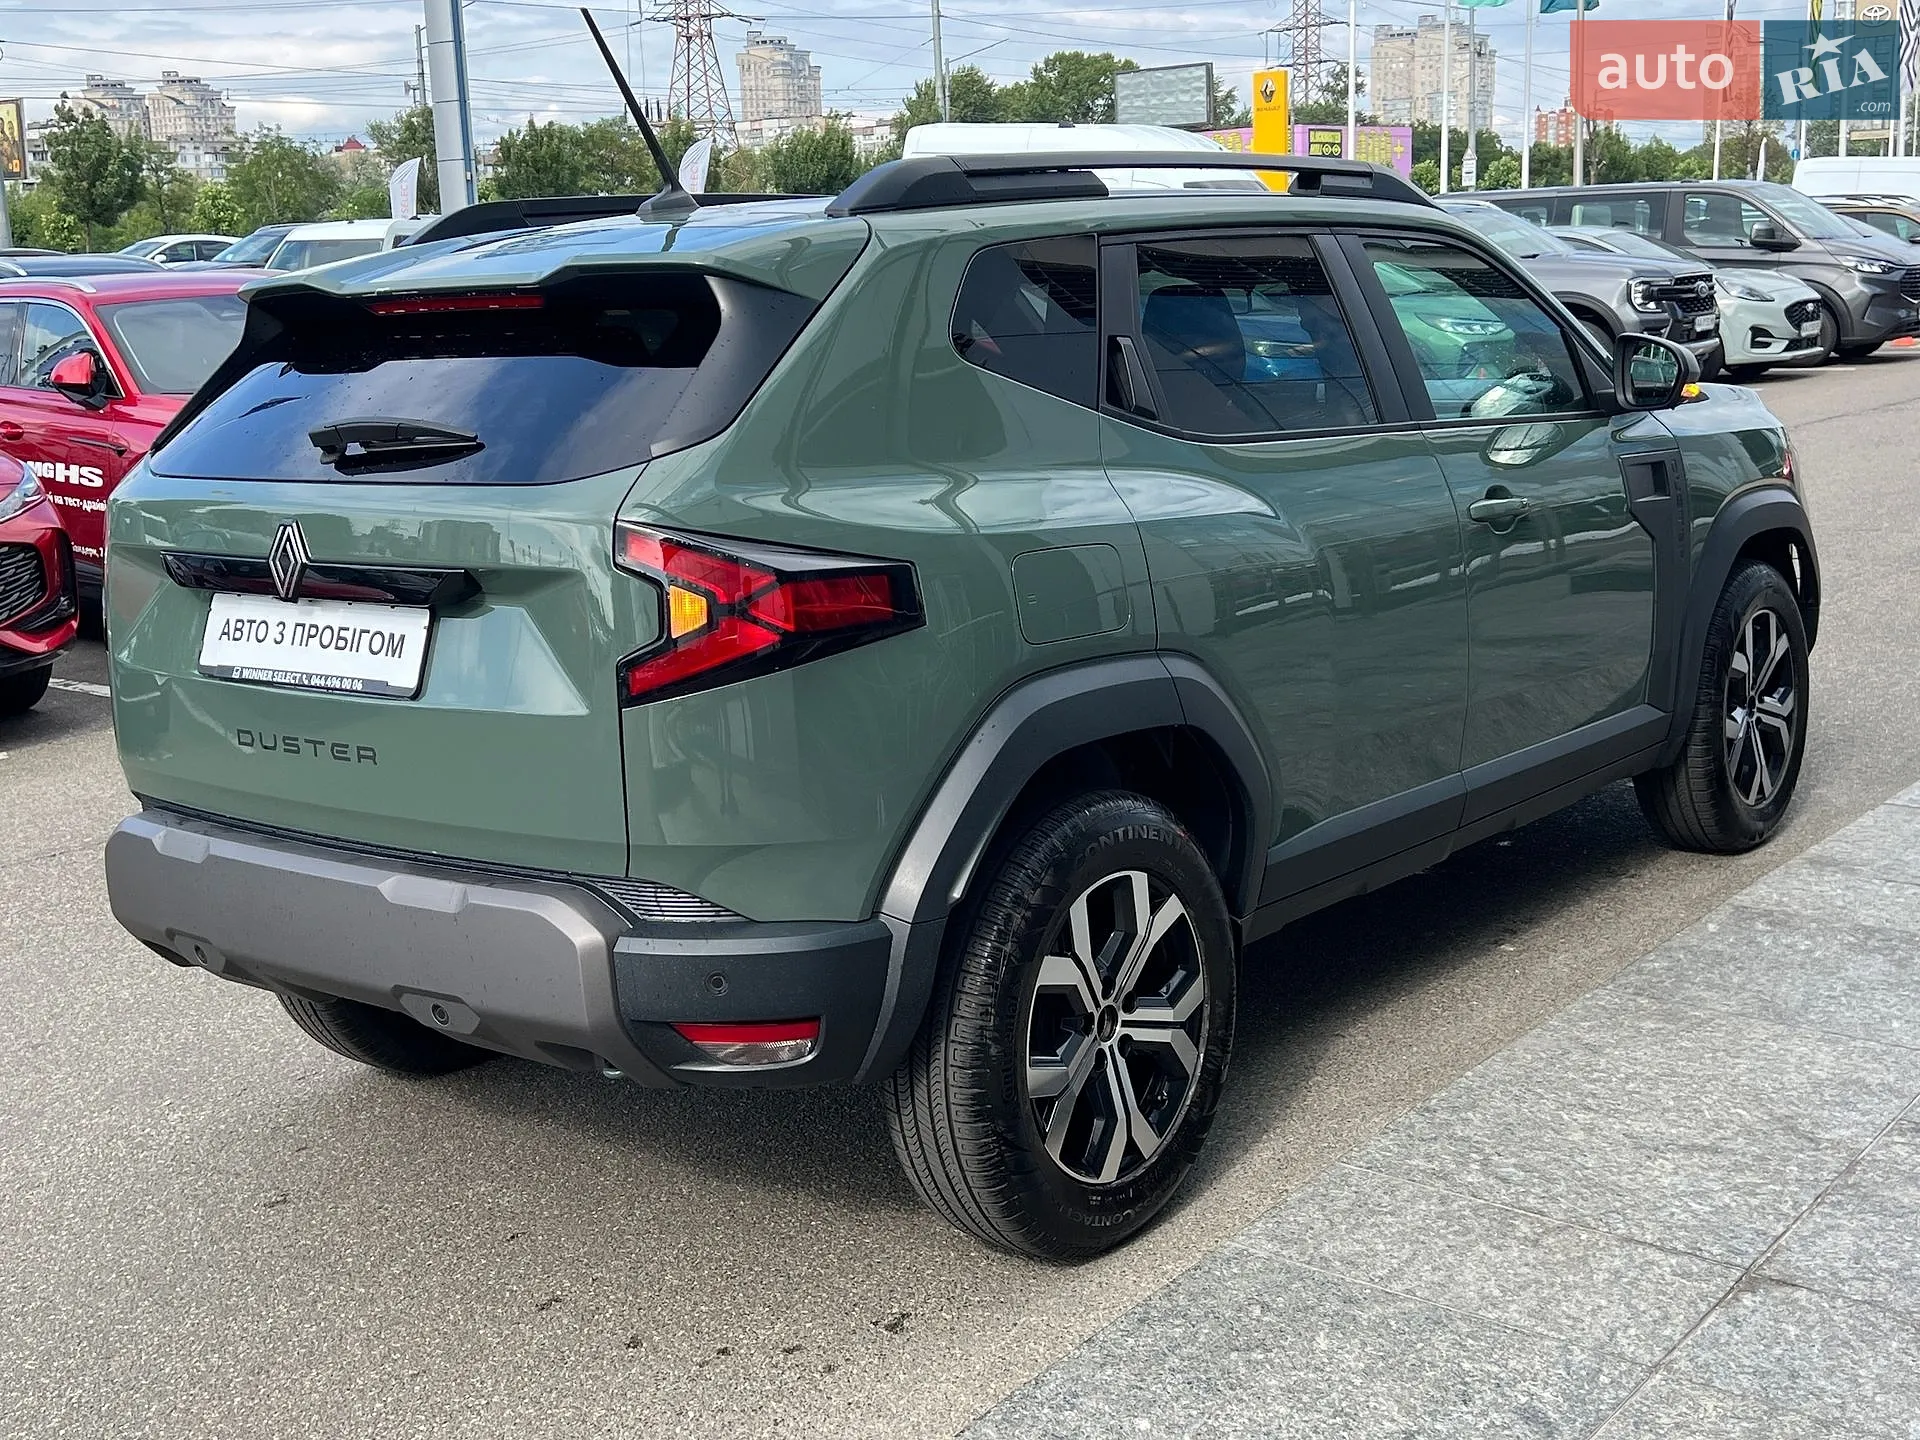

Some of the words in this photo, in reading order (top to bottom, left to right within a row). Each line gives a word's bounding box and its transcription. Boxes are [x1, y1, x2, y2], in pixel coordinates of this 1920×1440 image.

[218, 618, 269, 644] АВТО
[273, 621, 286, 645] З
[291, 622, 406, 659] ПРОБІГОМ
[242, 667, 273, 681] WINNER
[273, 670, 301, 684] SELECT
[310, 674, 326, 687] 044
[326, 676, 341, 689] 496
[341, 678, 352, 690] 00
[352, 679, 363, 691] 06
[236, 728, 378, 766] DUSTER
